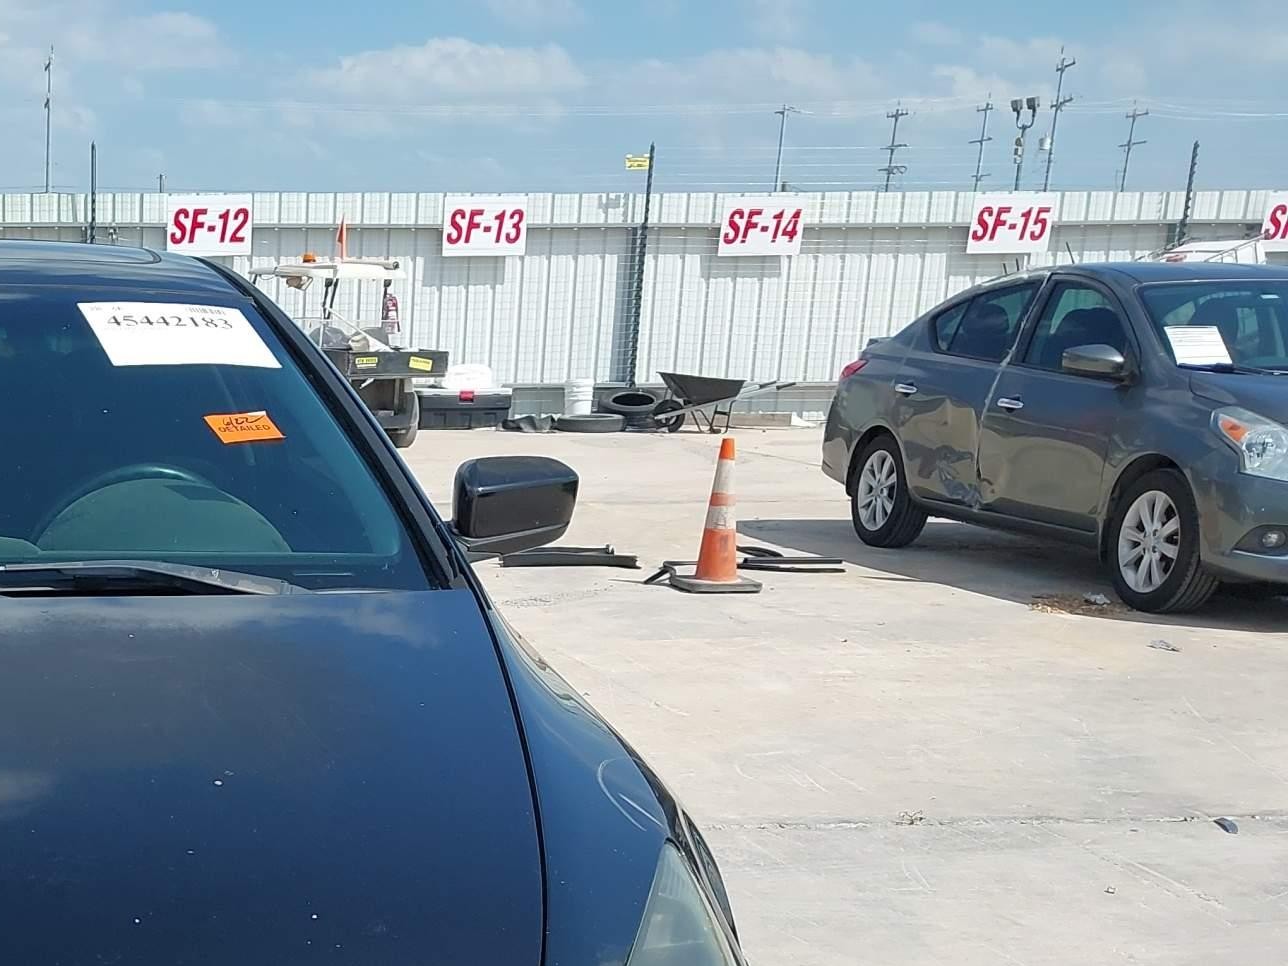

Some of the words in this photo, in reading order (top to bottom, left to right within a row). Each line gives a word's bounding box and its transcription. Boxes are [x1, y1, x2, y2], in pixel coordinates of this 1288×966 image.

[170, 207, 249, 245] SF-12
[446, 208, 524, 245] SF-13
[723, 208, 802, 245] SF-14
[972, 206, 1051, 241] SF-15
[106, 314, 234, 331] 45442183
[218, 424, 271, 433] DETAILED
